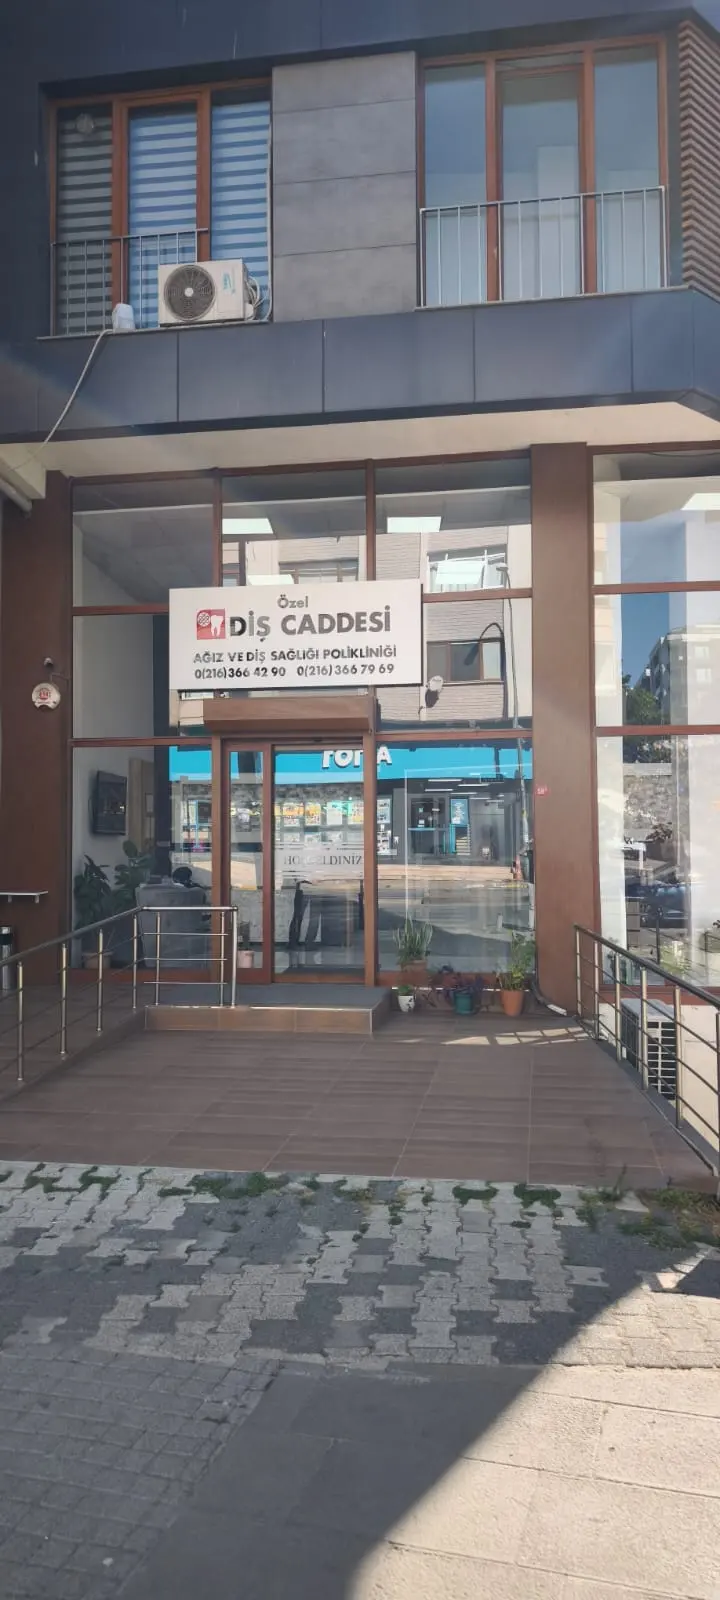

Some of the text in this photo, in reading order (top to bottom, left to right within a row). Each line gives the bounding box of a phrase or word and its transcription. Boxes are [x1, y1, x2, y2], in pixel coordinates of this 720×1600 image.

[277, 594, 309, 609] Özel
[229, 605, 391, 642] DİŞ CADDESİ
[193, 644, 397, 664] AĞIZ VE DİŞ SAĞLIĞI POLİKLİNİĞİ
[253, 667, 268, 678] 42
[271, 666, 286, 677] 90
[360, 664, 376, 675] 79
[378, 663, 394, 674] 69
